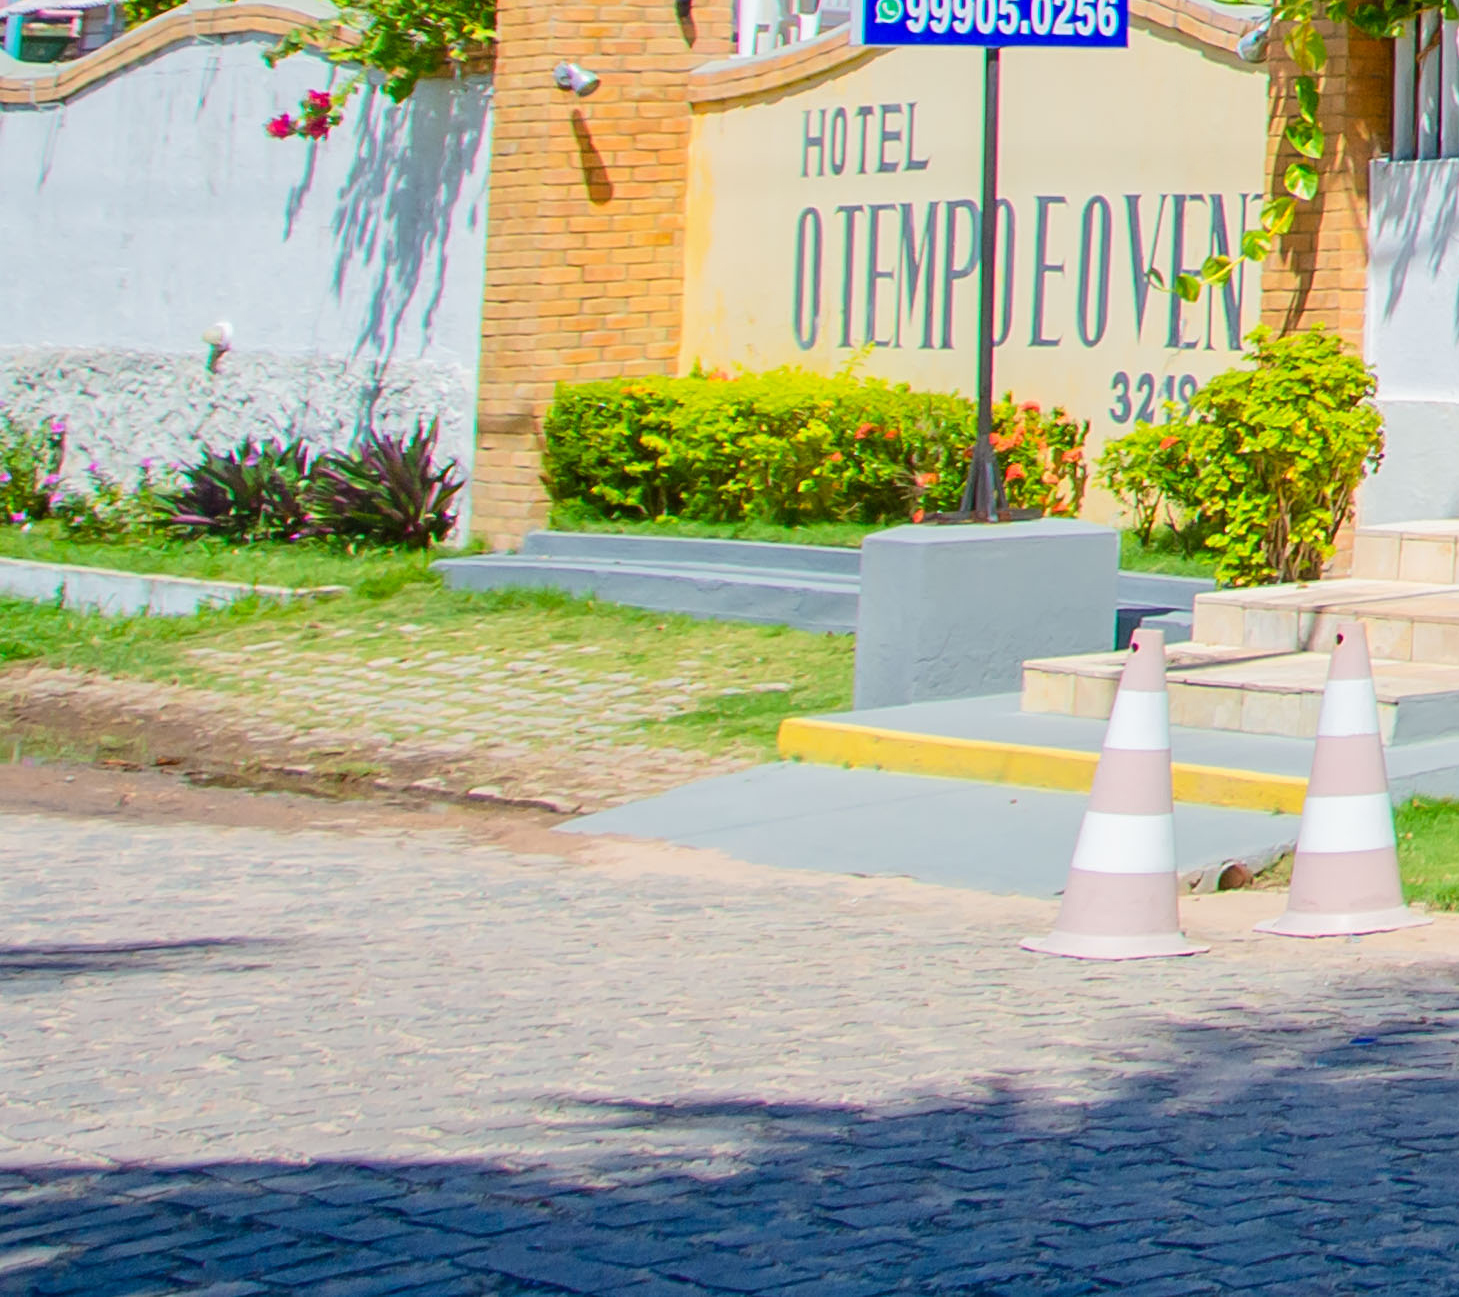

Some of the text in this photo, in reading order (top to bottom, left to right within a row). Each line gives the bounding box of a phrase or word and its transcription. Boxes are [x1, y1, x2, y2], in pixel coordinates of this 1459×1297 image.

[801, 102, 930, 178] HOTEL
[794, 192, 1264, 351] O TEMPO E O VEN
